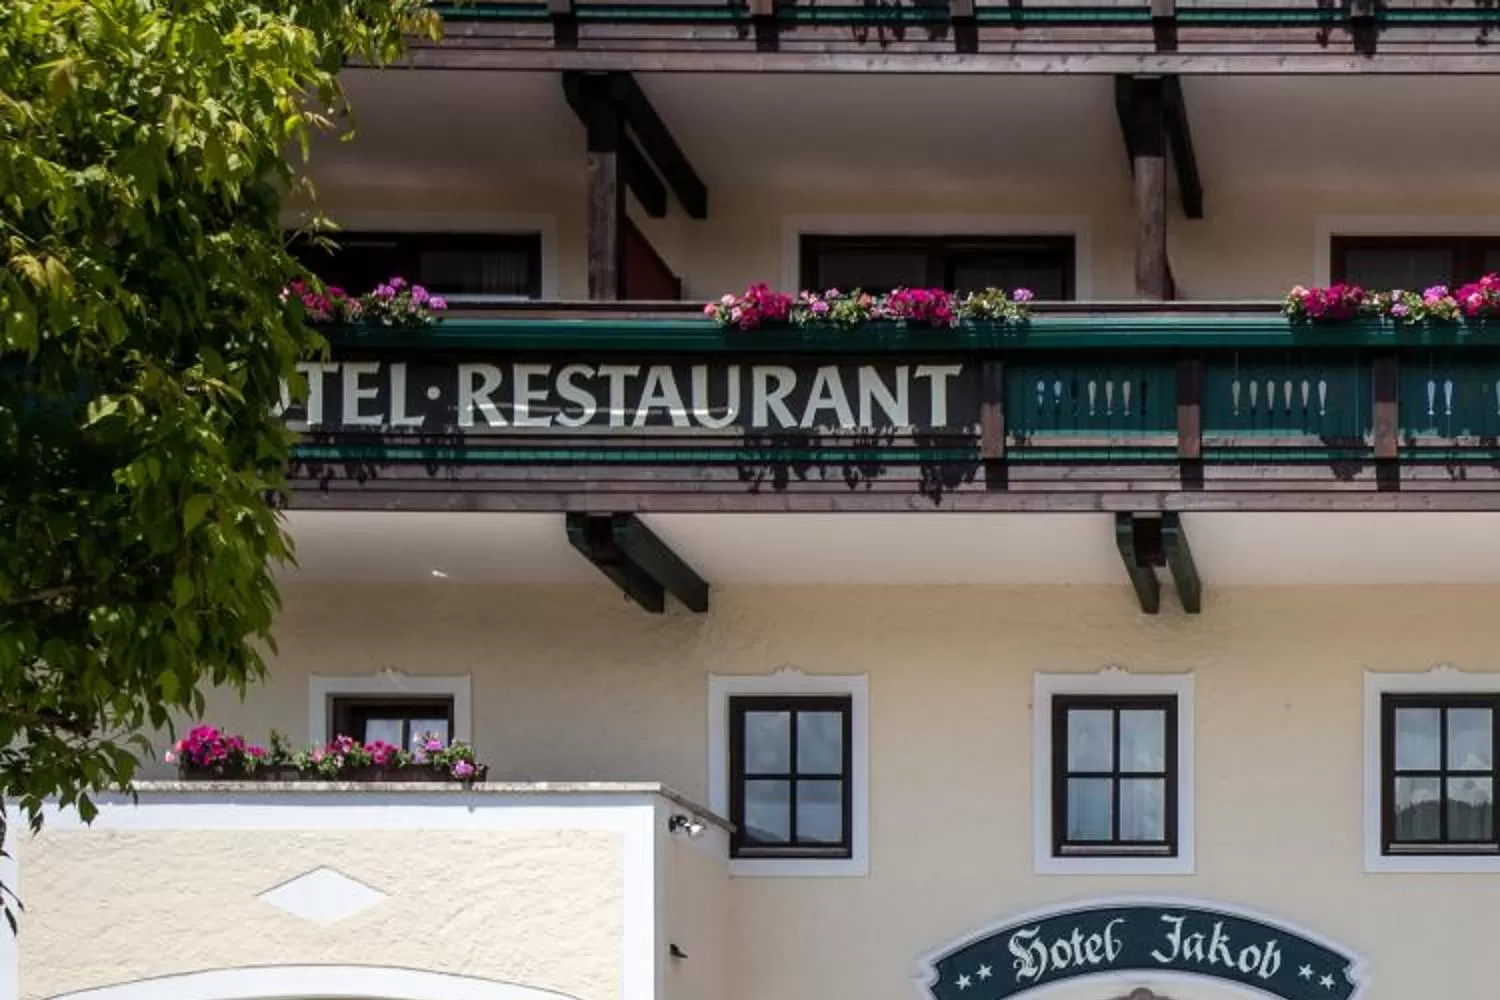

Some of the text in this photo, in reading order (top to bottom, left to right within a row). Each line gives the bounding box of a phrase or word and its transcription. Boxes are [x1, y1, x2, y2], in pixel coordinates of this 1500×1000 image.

[456, 362, 963, 428] RESTAURANT
[1008, 914, 1281, 982] Hotel Jakob
